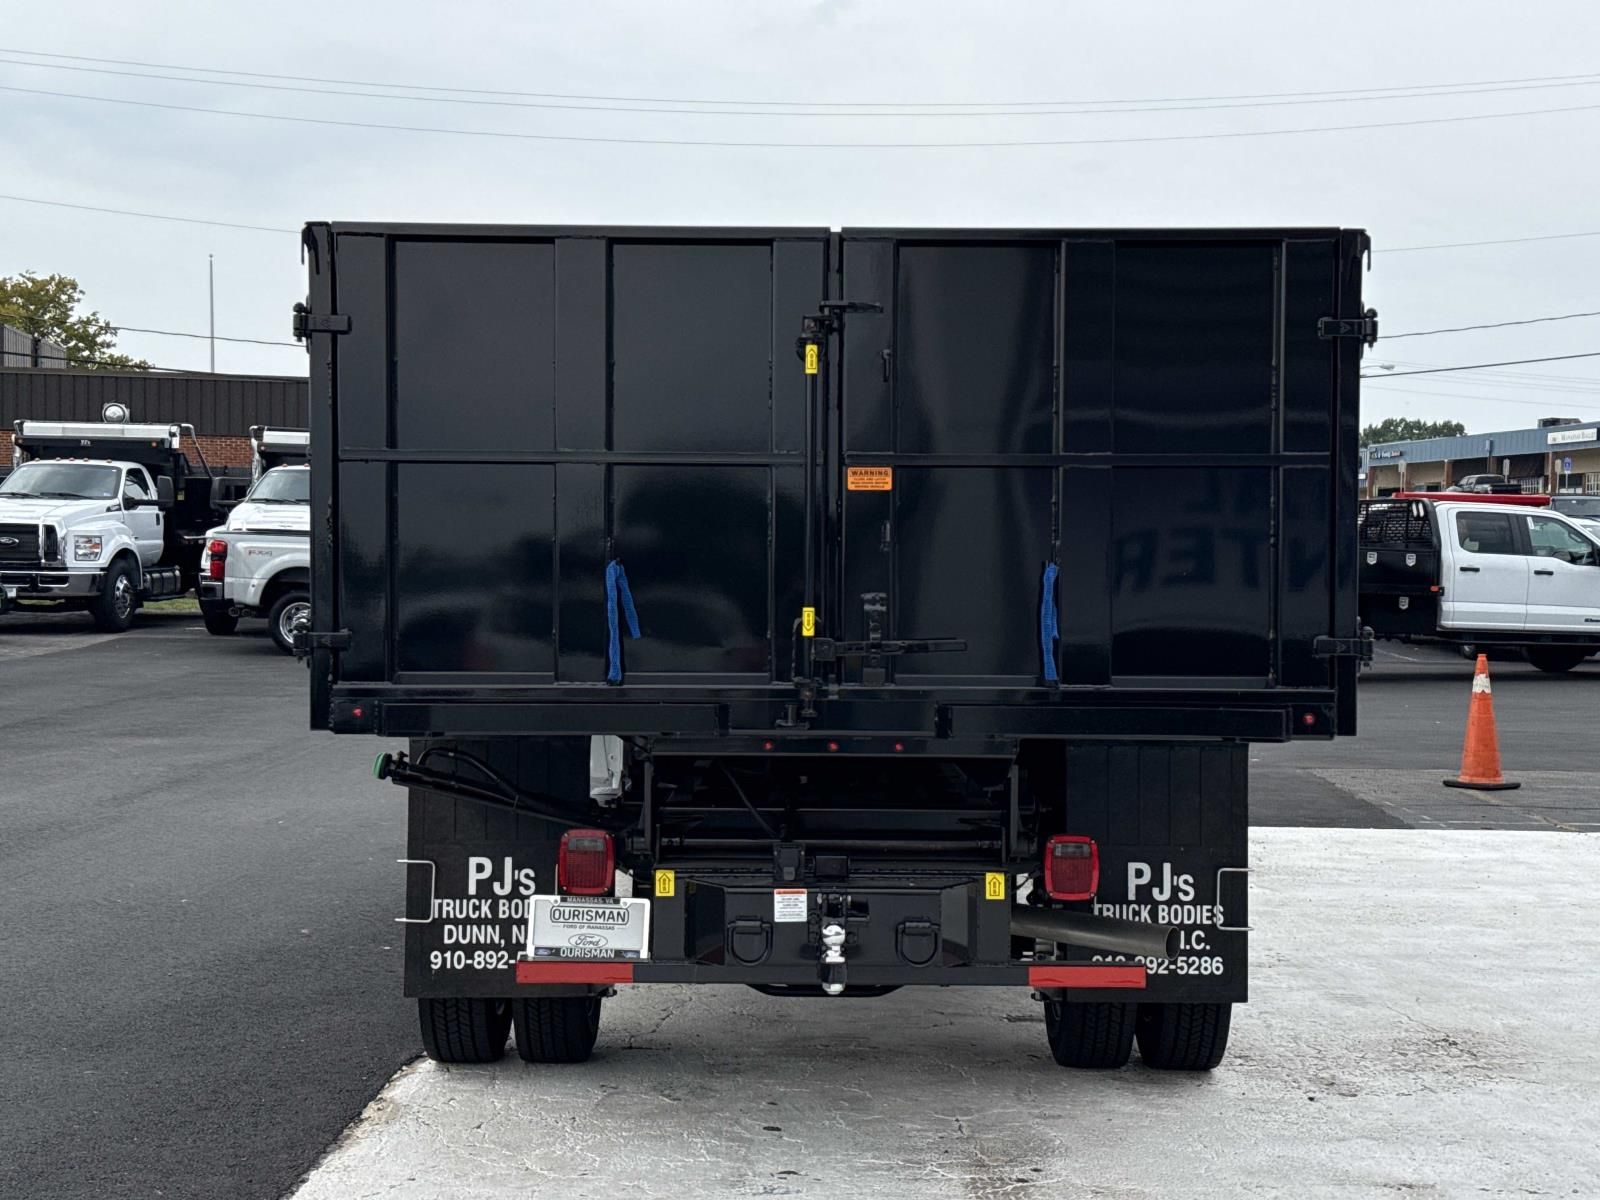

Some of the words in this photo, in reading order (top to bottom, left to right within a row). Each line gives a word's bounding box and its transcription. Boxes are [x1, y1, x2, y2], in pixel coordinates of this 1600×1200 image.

[468, 856, 536, 896] PJ's
[1127, 861, 1196, 902] PJ's
[432, 898, 492, 919] TRUCK
[552, 907, 626, 923] OURISMAN
[1158, 904, 1224, 925] BODIES
[443, 924, 505, 947] DUNN,
[574, 935, 601, 947] Ford
[560, 947, 615, 959] OURISMAN
